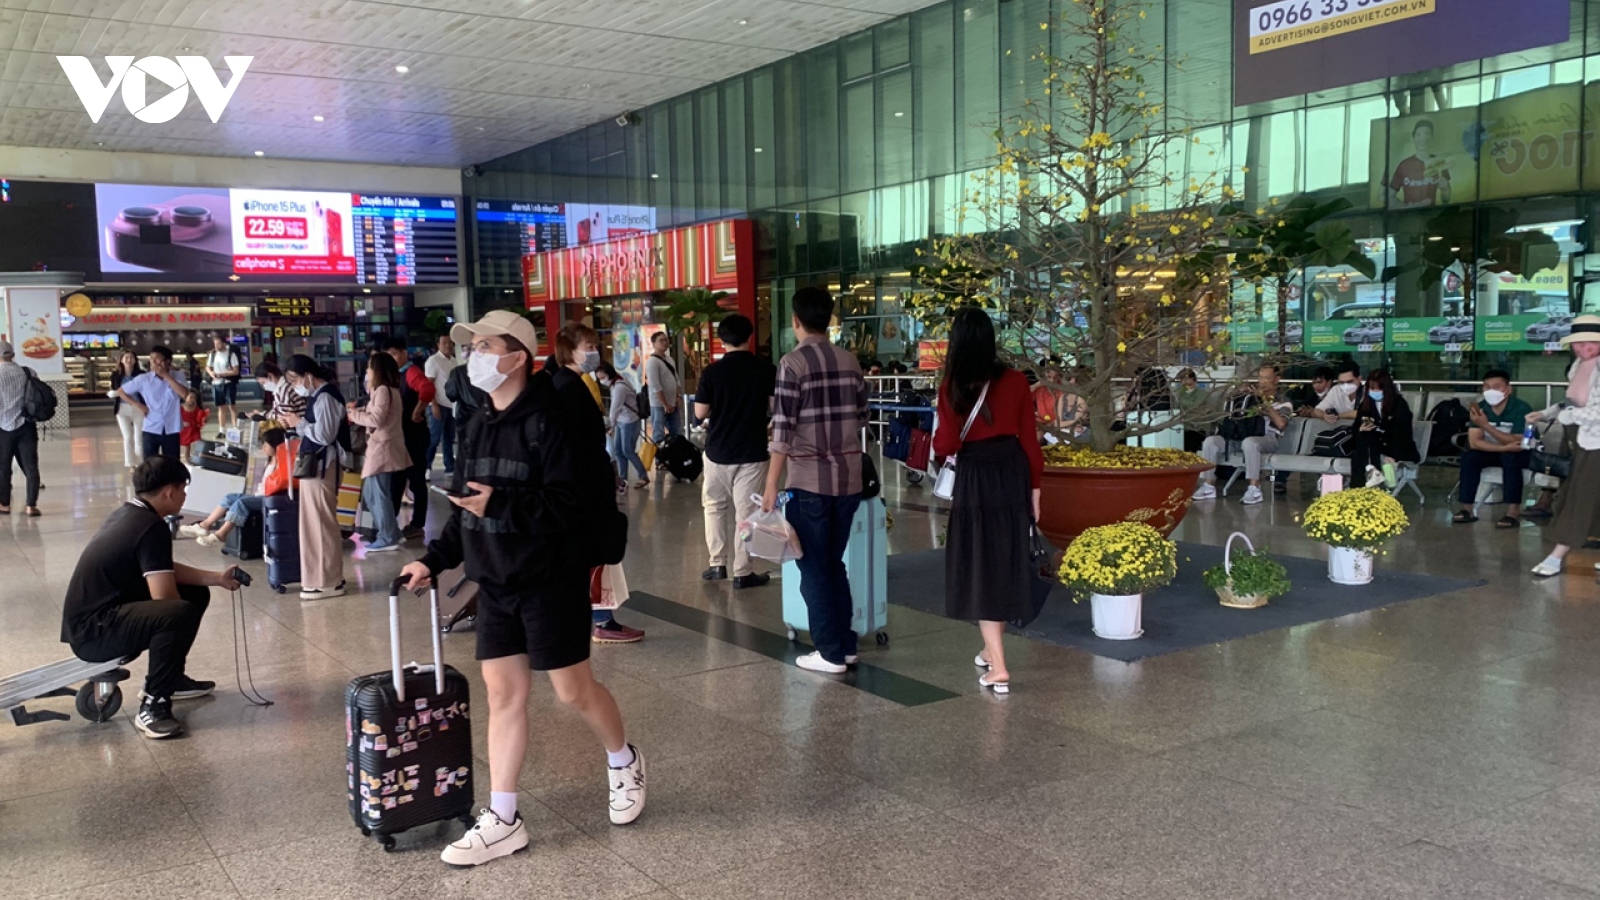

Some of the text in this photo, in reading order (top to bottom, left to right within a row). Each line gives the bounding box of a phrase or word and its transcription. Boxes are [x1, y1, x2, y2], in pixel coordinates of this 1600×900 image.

[1259, 6, 1312, 31] 0966
[1259, 0, 1426, 47] ADVERTISING@SONGVIET.COM.VN
[250, 200, 307, 213] iPhone 15 Plus
[248, 218, 285, 236] 22.59
[599, 247, 663, 273] PHOENIX
[83, 312, 245, 324] LUCKY CAFE & FASTFOOD
[1392, 321, 1410, 329] Grab
[274, 325, 310, 338] G H
